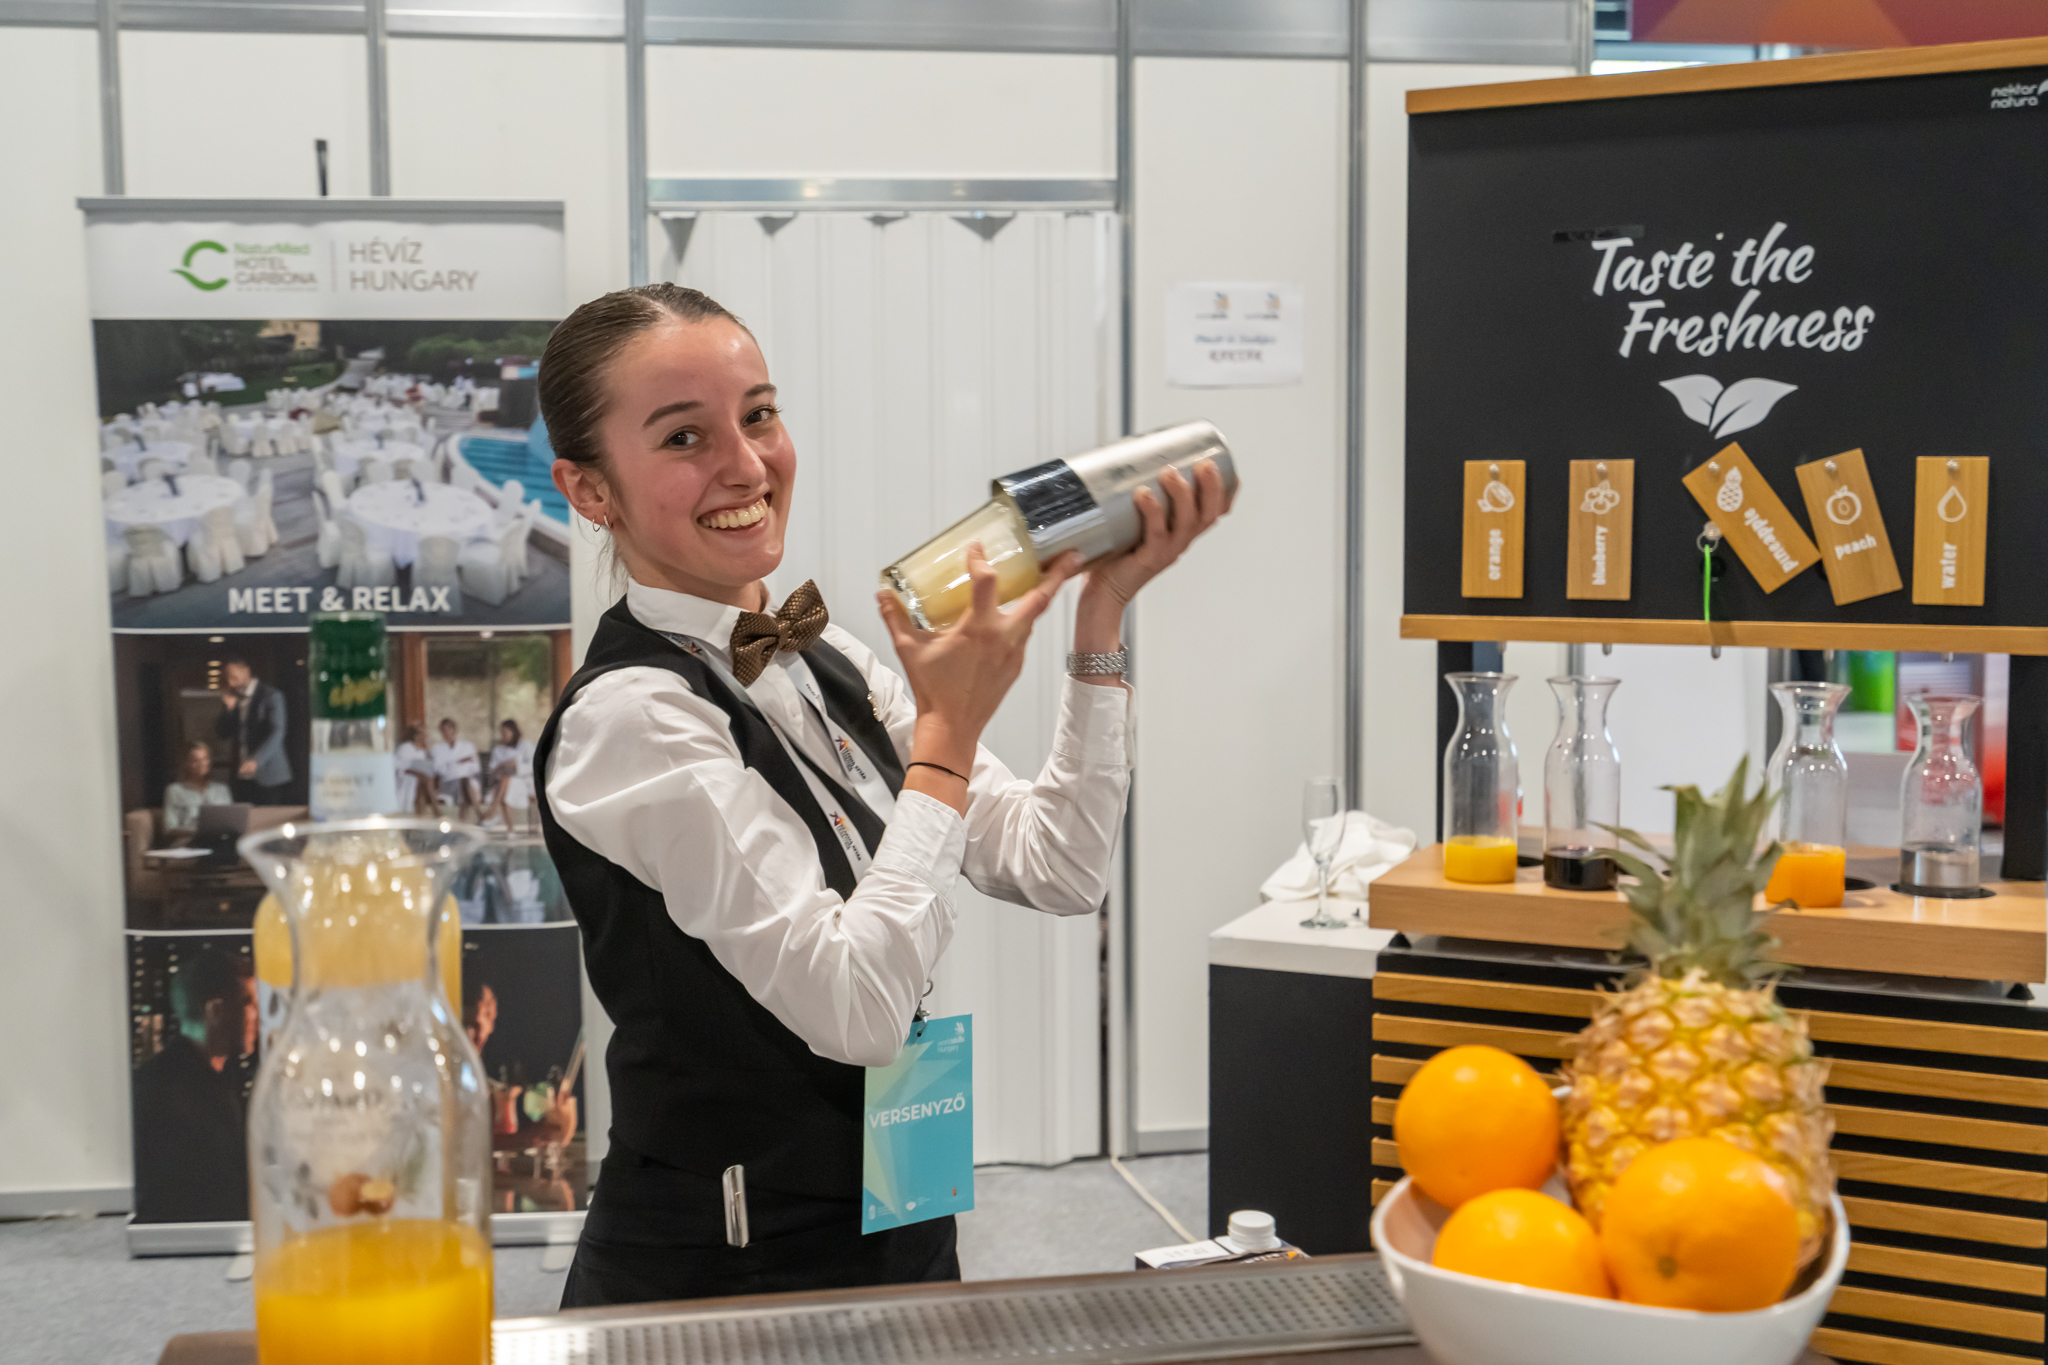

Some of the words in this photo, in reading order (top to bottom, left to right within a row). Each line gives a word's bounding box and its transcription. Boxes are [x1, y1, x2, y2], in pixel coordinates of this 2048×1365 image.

[1991, 83, 2038, 97] nektar
[1991, 96, 2039, 109] natura
[349, 236, 424, 264] HÉVÍZ
[1591, 237, 1715, 296] Taste
[1731, 221, 1815, 286] the
[350, 269, 478, 292] HUNGARY
[1618, 288, 1875, 358] Freshness
[1488, 528, 1504, 580] orange
[1592, 525, 1608, 585] blueberry
[1744, 508, 1799, 573] pineapple
[1834, 533, 1877, 560] peach
[1940, 542, 1957, 589] water
[228, 586, 312, 613] MEET
[320, 586, 345, 611] &
[352, 586, 450, 612] RELAX
[868, 1092, 965, 1129] VERSENYZŐ
